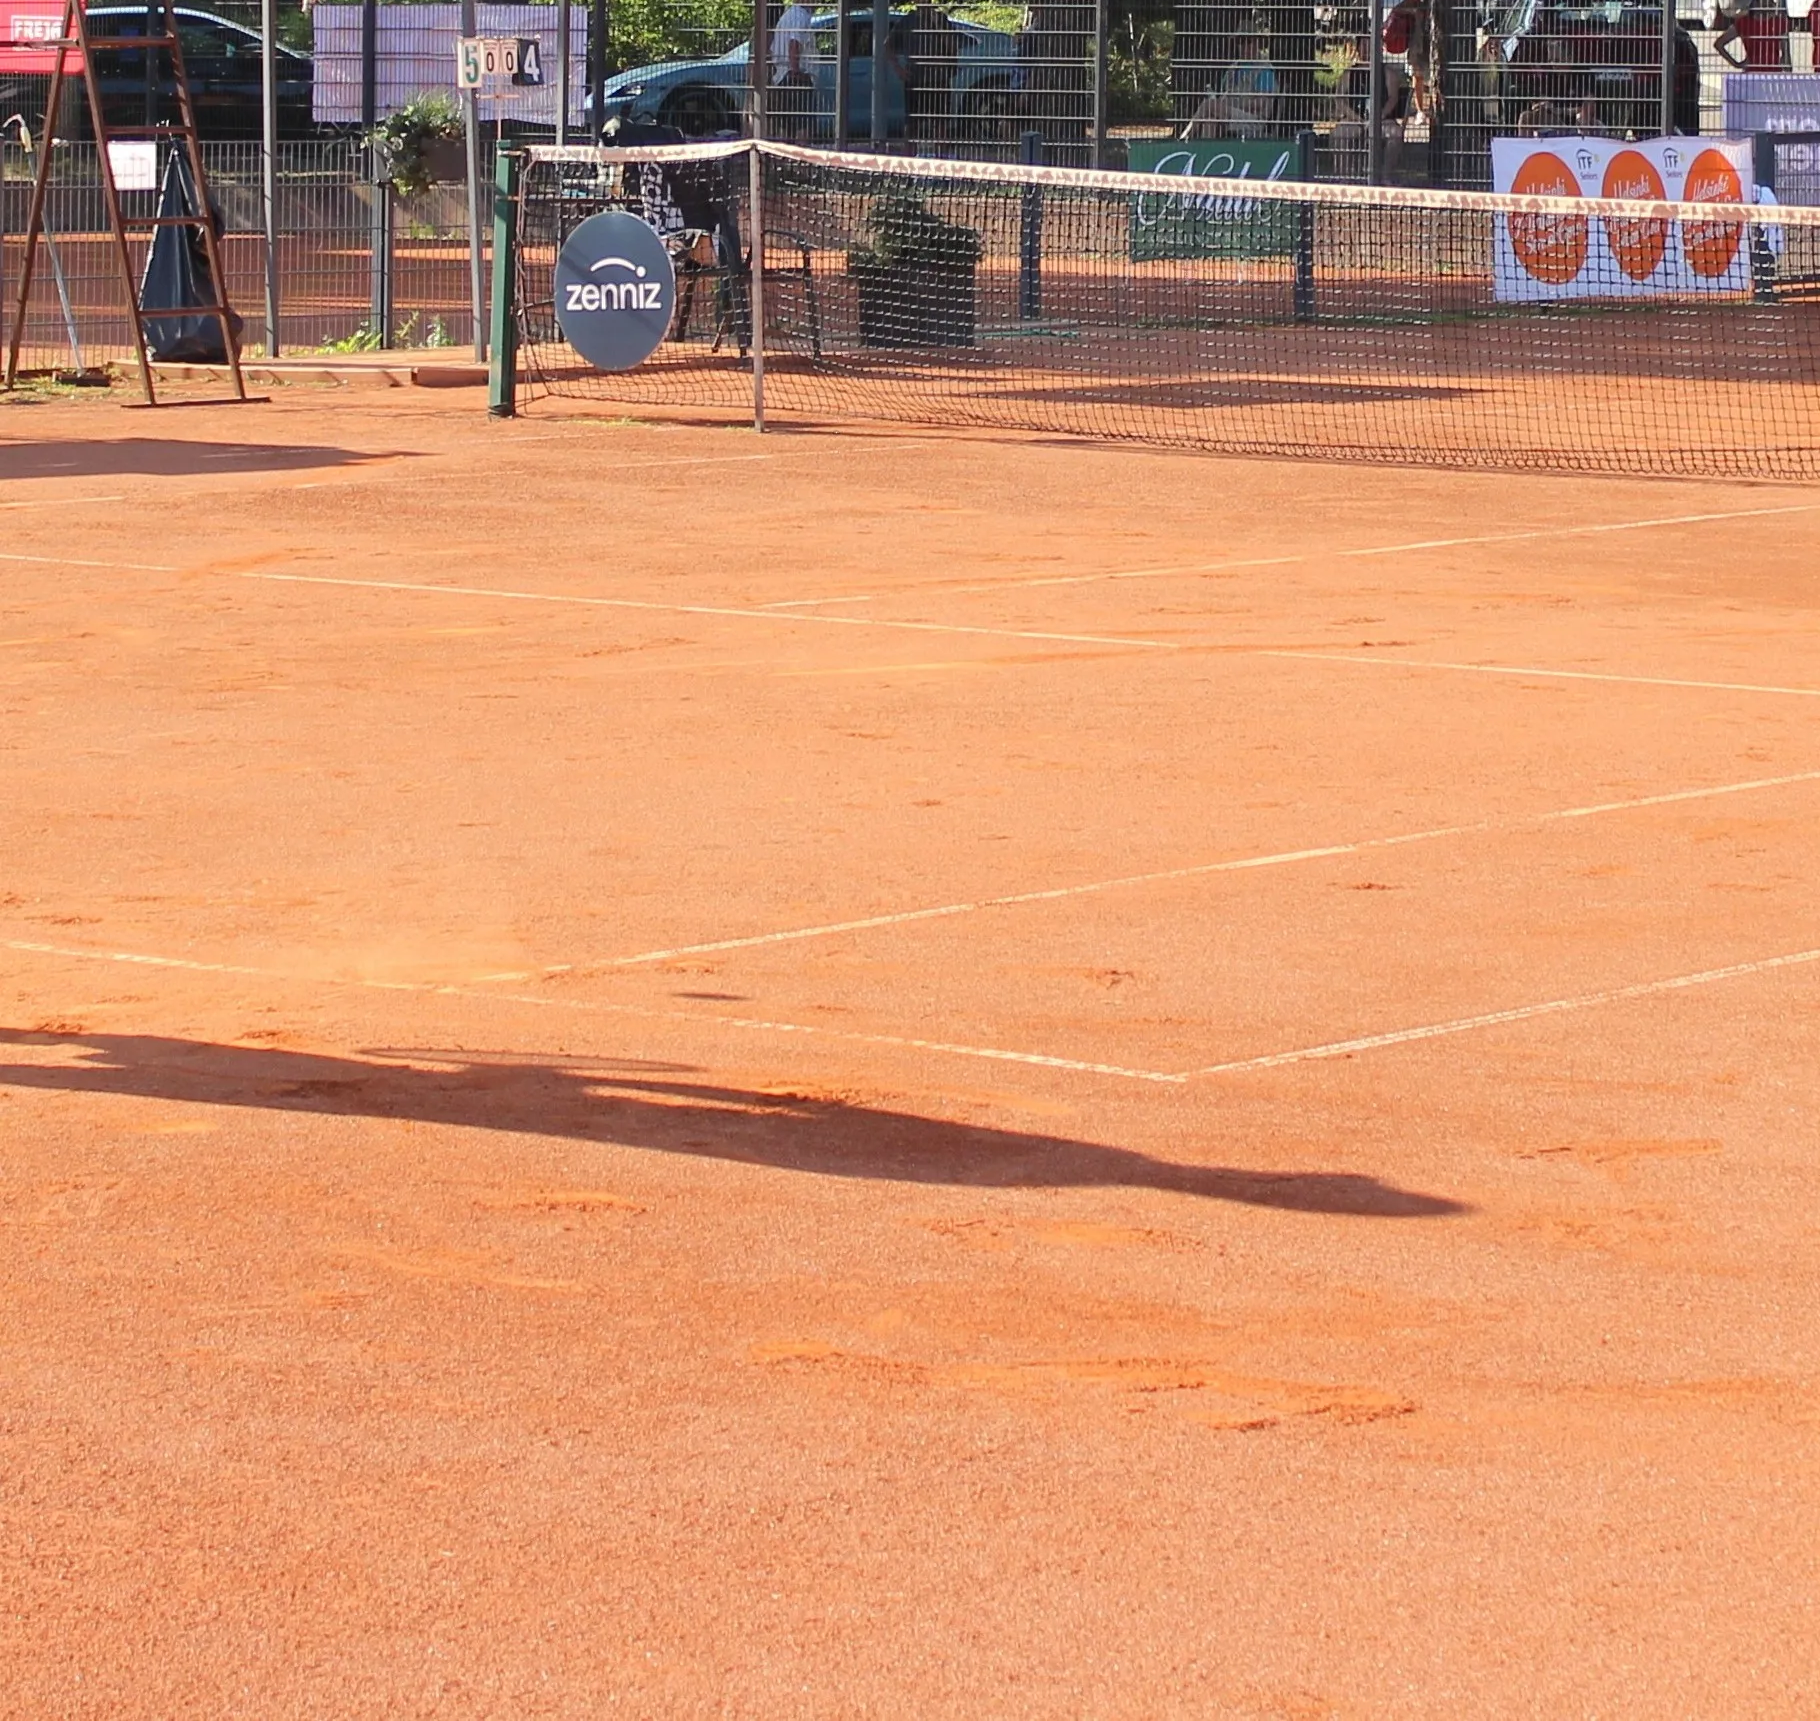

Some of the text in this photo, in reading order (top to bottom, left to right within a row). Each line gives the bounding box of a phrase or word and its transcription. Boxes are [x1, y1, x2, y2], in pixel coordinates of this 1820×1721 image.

[465, 44, 540, 83] 5 0 0 4
[1577, 154, 1593, 171] ITF
[1664, 153, 1679, 169] ITF
[566, 281, 663, 311] zenniz
